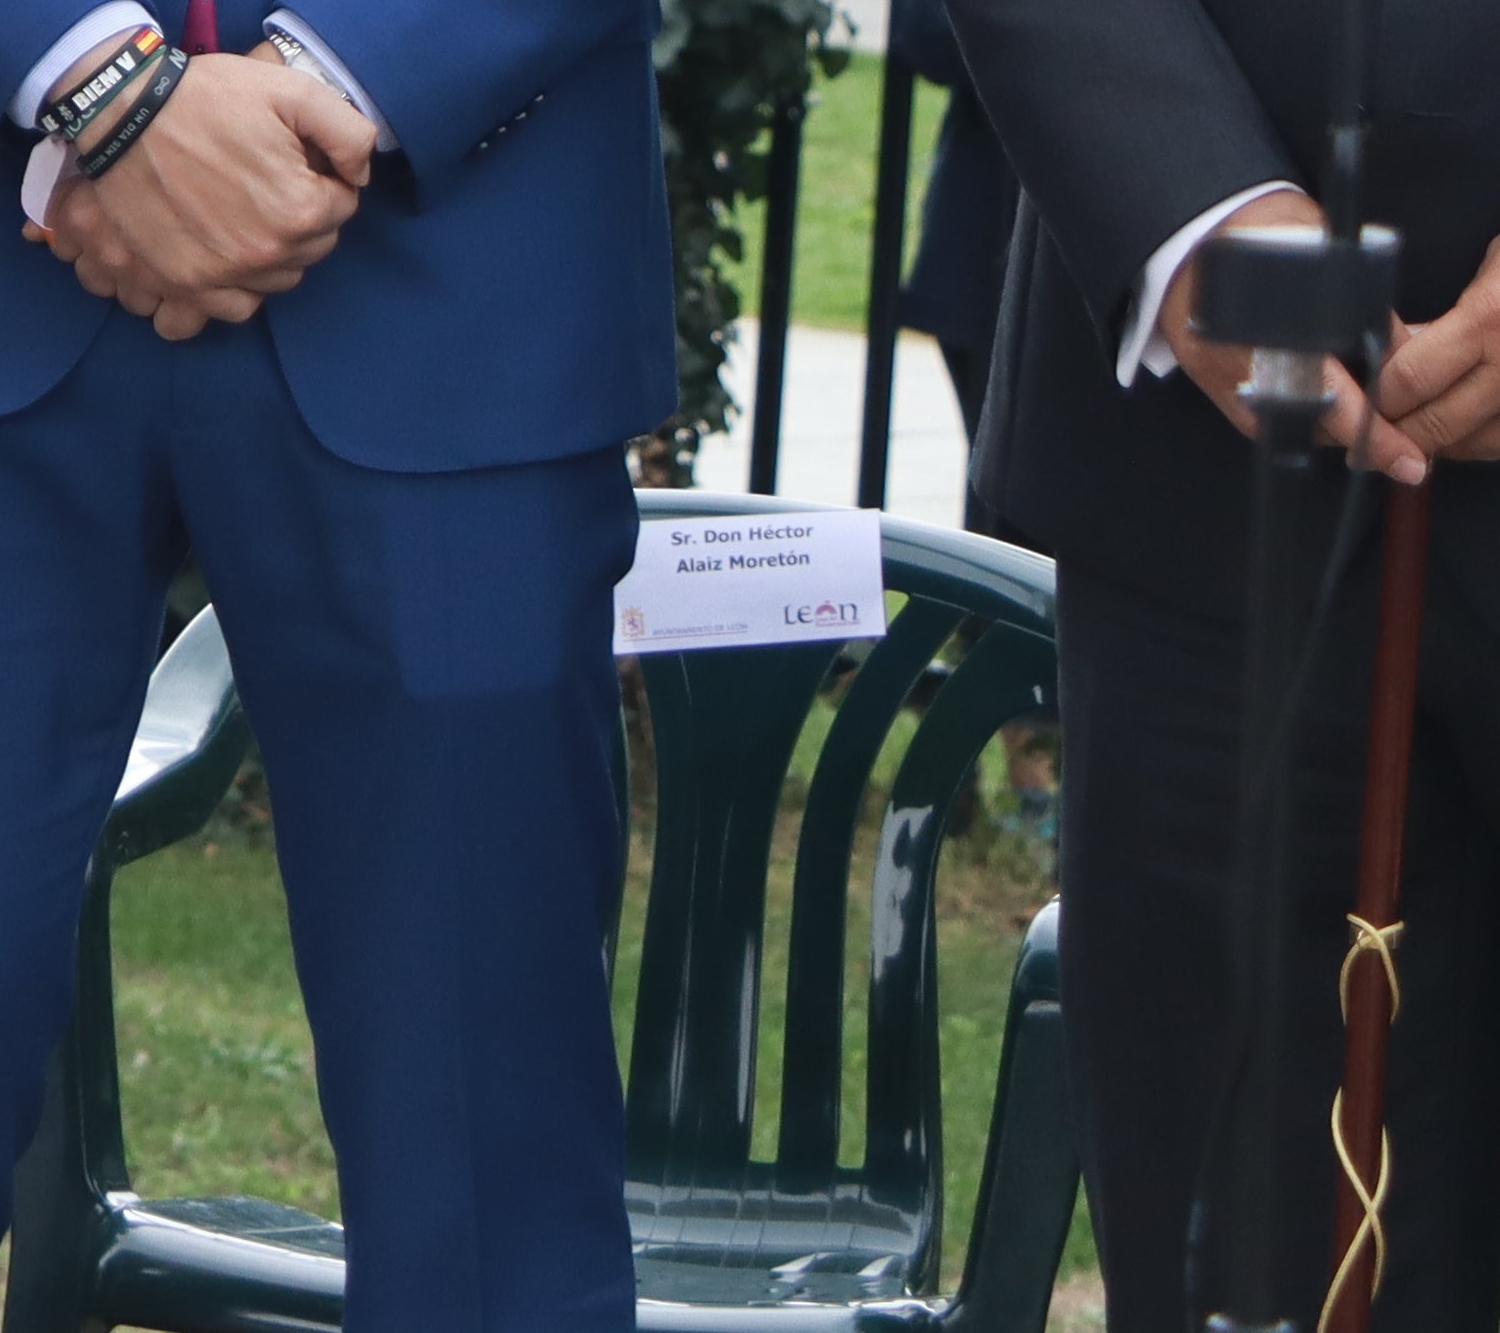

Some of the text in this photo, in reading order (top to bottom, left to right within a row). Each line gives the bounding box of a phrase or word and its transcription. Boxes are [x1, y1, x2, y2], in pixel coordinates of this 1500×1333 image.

[72, 65, 122, 110] BIEM
[115, 50, 136, 72] V
[670, 523, 814, 547] Sr. Don Héctor
[676, 549, 811, 574] Alaiz Moretón
